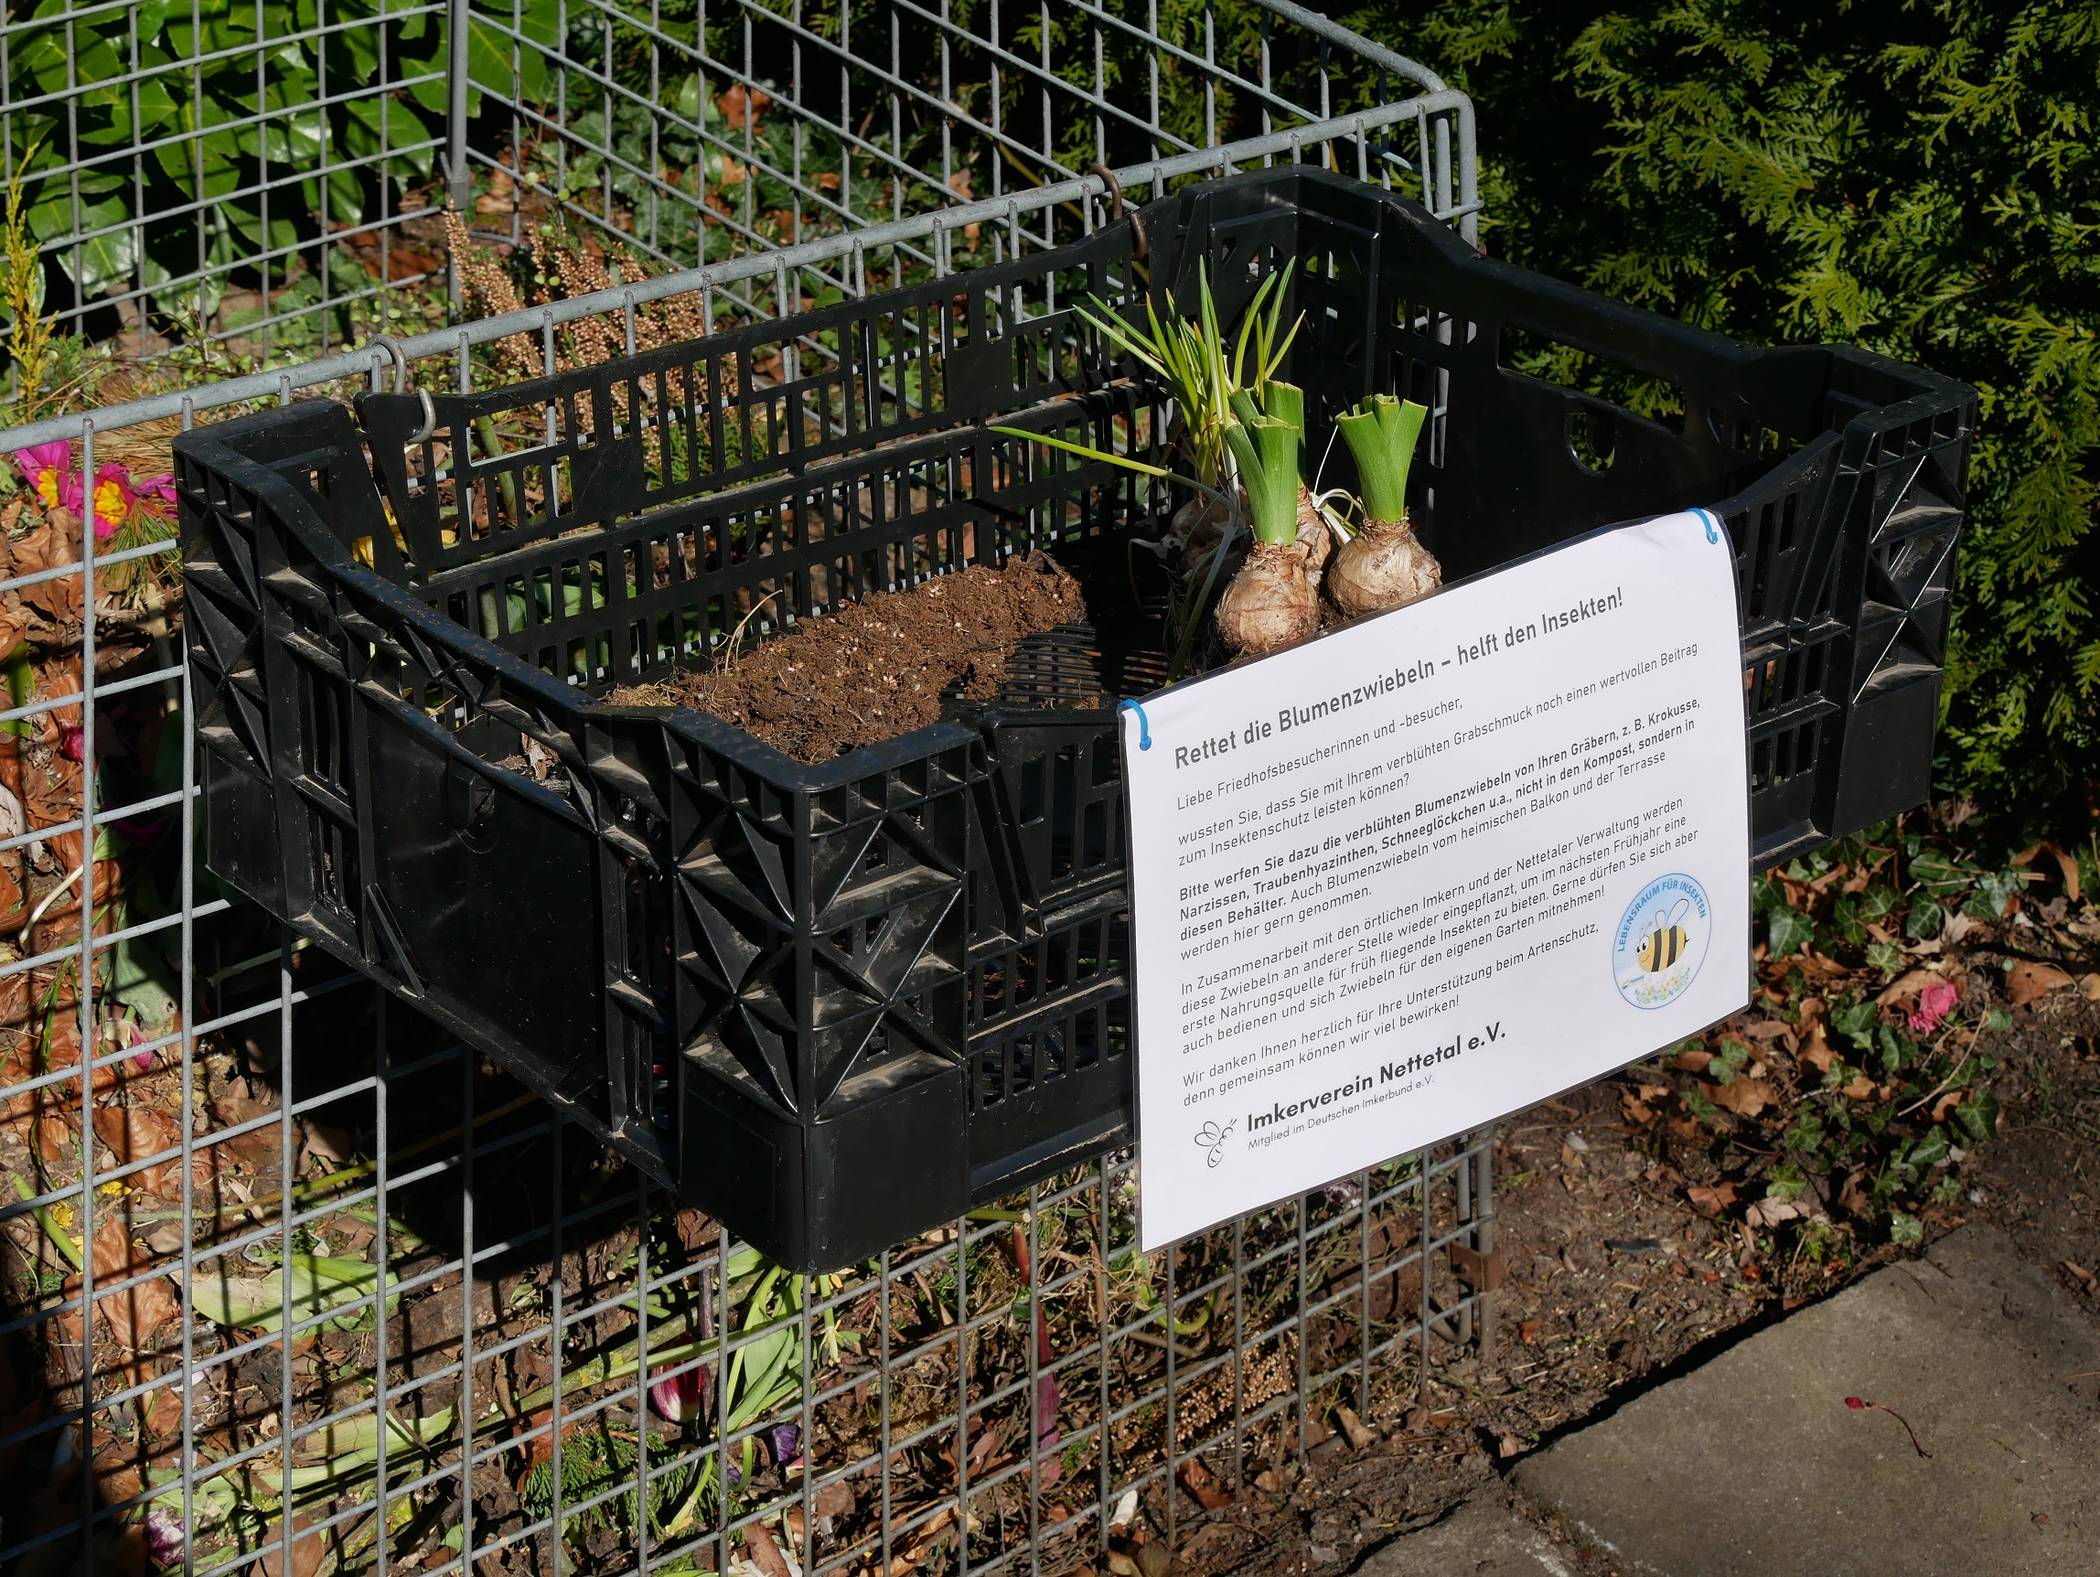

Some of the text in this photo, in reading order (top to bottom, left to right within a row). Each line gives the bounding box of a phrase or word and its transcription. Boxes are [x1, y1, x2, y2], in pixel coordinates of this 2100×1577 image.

[1174, 730, 1237, 769] Rettet
[1243, 720, 1272, 745] die
[1278, 659, 1435, 733] Blumenzwiebeln
[1457, 633, 1499, 666] helft
[1504, 623, 1537, 648] den
[1541, 586, 1623, 635] Insekten!
[1177, 698, 1463, 811] Liebe Friedhofsbesucherinnen und -besucher,
[1178, 643, 1698, 846] wussten Sie, dass Sie mit Ihrem verblühten Grabschmuck noch einen wertvollen Beitrag
[1178, 772, 1410, 867] zum Insektenschutz leisten können?
[1179, 699, 1700, 902] Bitte werfen Sie dazu die verblühten Blumenzwiebeln von Ihren Gräbern, z. B. Krokusse,
[1180, 719, 1695, 922] Narzissen, Traubenhyazinthen, Schneeglöckchen u.a., nicht in den Kompost, sondern in
[1180, 751, 1666, 942] diesen Behälter. Auch Blumenzwiebeln vom heimischen Balkon und der Terrasse
[1180, 887, 1372, 961] werden hier gern genommen.
[1181, 798, 1683, 996] In Zusammenarbeit mit den örtlichen Imkern und der Nettetaler Verwaltung werden
[1181, 816, 1687, 1015] diese Zwiebeln an anderer Stelle wieder eingepflanzt, um im nächsten Frühjahr eine
[1182, 829, 1698, 1035] erste Nahrungsquelle für früh fliegende Insekten zu bieten. Gerne dürfen Sie sich aber
[1182, 884, 1605, 1055] auch bedienen und sich Zwiebeln für den eigenen Garten mitnehmen!
[1618, 879, 1707, 952] LEBENSRAUM FÜR INSEKTEN
[1182, 923, 1599, 1087] Wir danken Ihnen herzlich für Ihre Unterstützung beim Artenschutz,
[1183, 993, 1459, 1107] denn gemeinsam können wir viel bewirken!
[1247, 1021, 1506, 1132] Imkerverein Nettetal e.V.
[1247, 1125, 1290, 1150] Mitglied
[1293, 1124, 1305, 1134] im
[1307, 1103, 1360, 1129] Deutschen
[1362, 1080, 1413, 1109] Imkerbund
